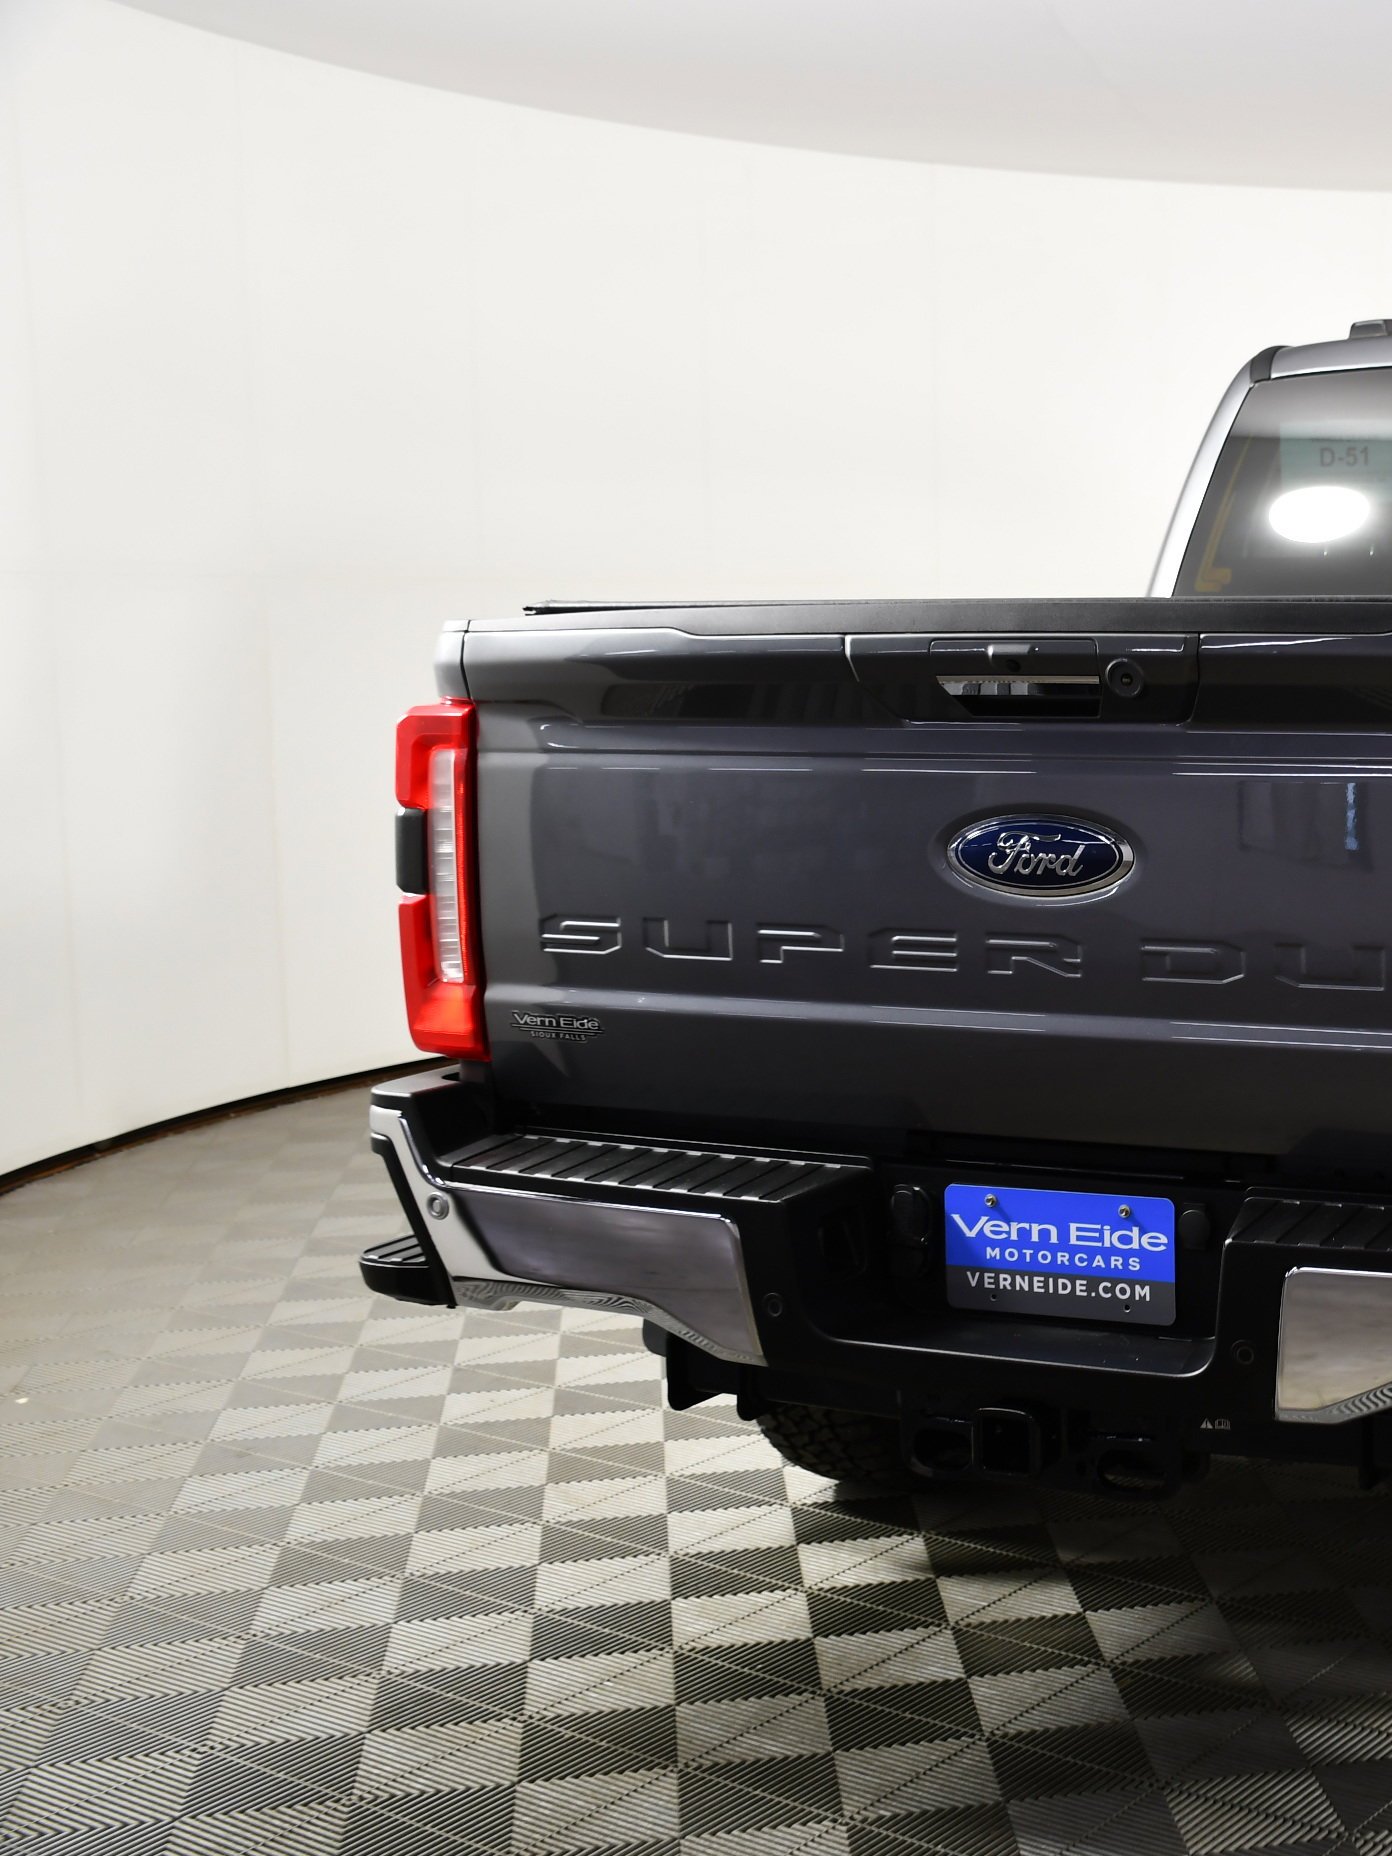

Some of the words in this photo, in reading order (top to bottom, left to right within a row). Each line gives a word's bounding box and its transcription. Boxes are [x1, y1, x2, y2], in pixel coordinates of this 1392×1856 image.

[1319, 446, 1369, 467] D-51
[987, 831, 1085, 877] Ford
[539, 913, 1082, 979] SUPER
[513, 1013, 556, 1027] Vern
[560, 1017, 599, 1030] Eide
[560, 1033, 586, 1041] FALLS
[951, 1213, 1060, 1244] Vern
[1069, 1222, 1169, 1252] Eide
[985, 1246, 1142, 1271] MOTORCARS
[966, 1271, 1151, 1302] VERNEIDE.COM
